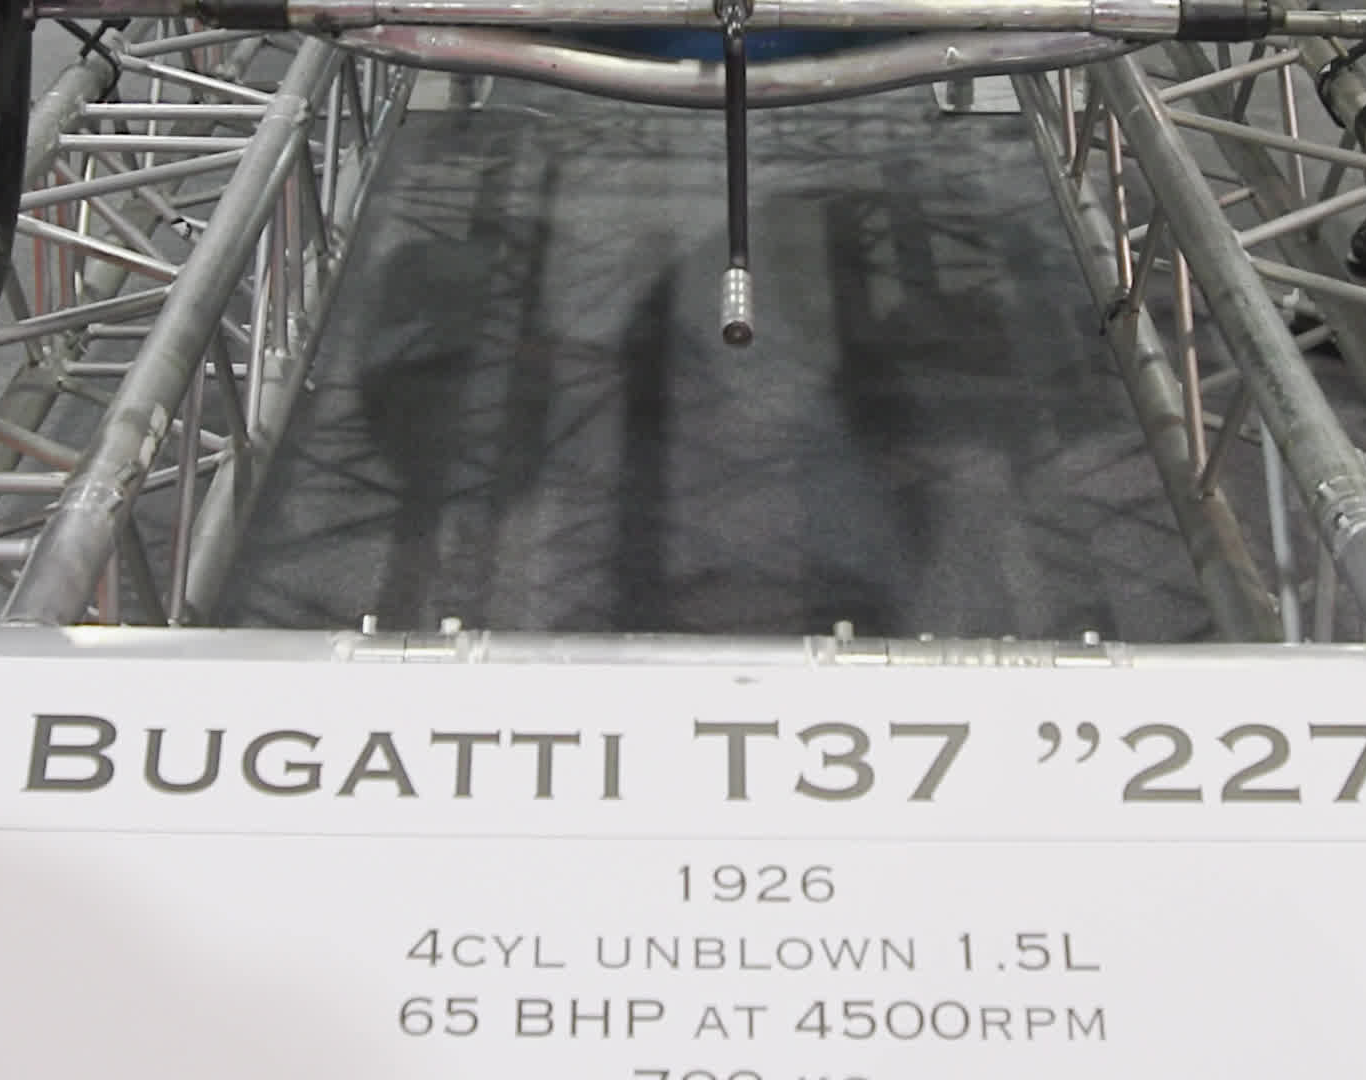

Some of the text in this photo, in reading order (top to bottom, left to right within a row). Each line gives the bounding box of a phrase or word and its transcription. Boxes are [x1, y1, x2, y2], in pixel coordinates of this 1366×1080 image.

[22, 714, 622, 800] BUGATTI
[694, 720, 970, 801] T37
[680, 865, 834, 902] 1926
[407, 928, 1099, 971] 4CYL UNBLOWN 1.5L
[399, 997, 1106, 1040] 65 BHP AT 4500RPM
